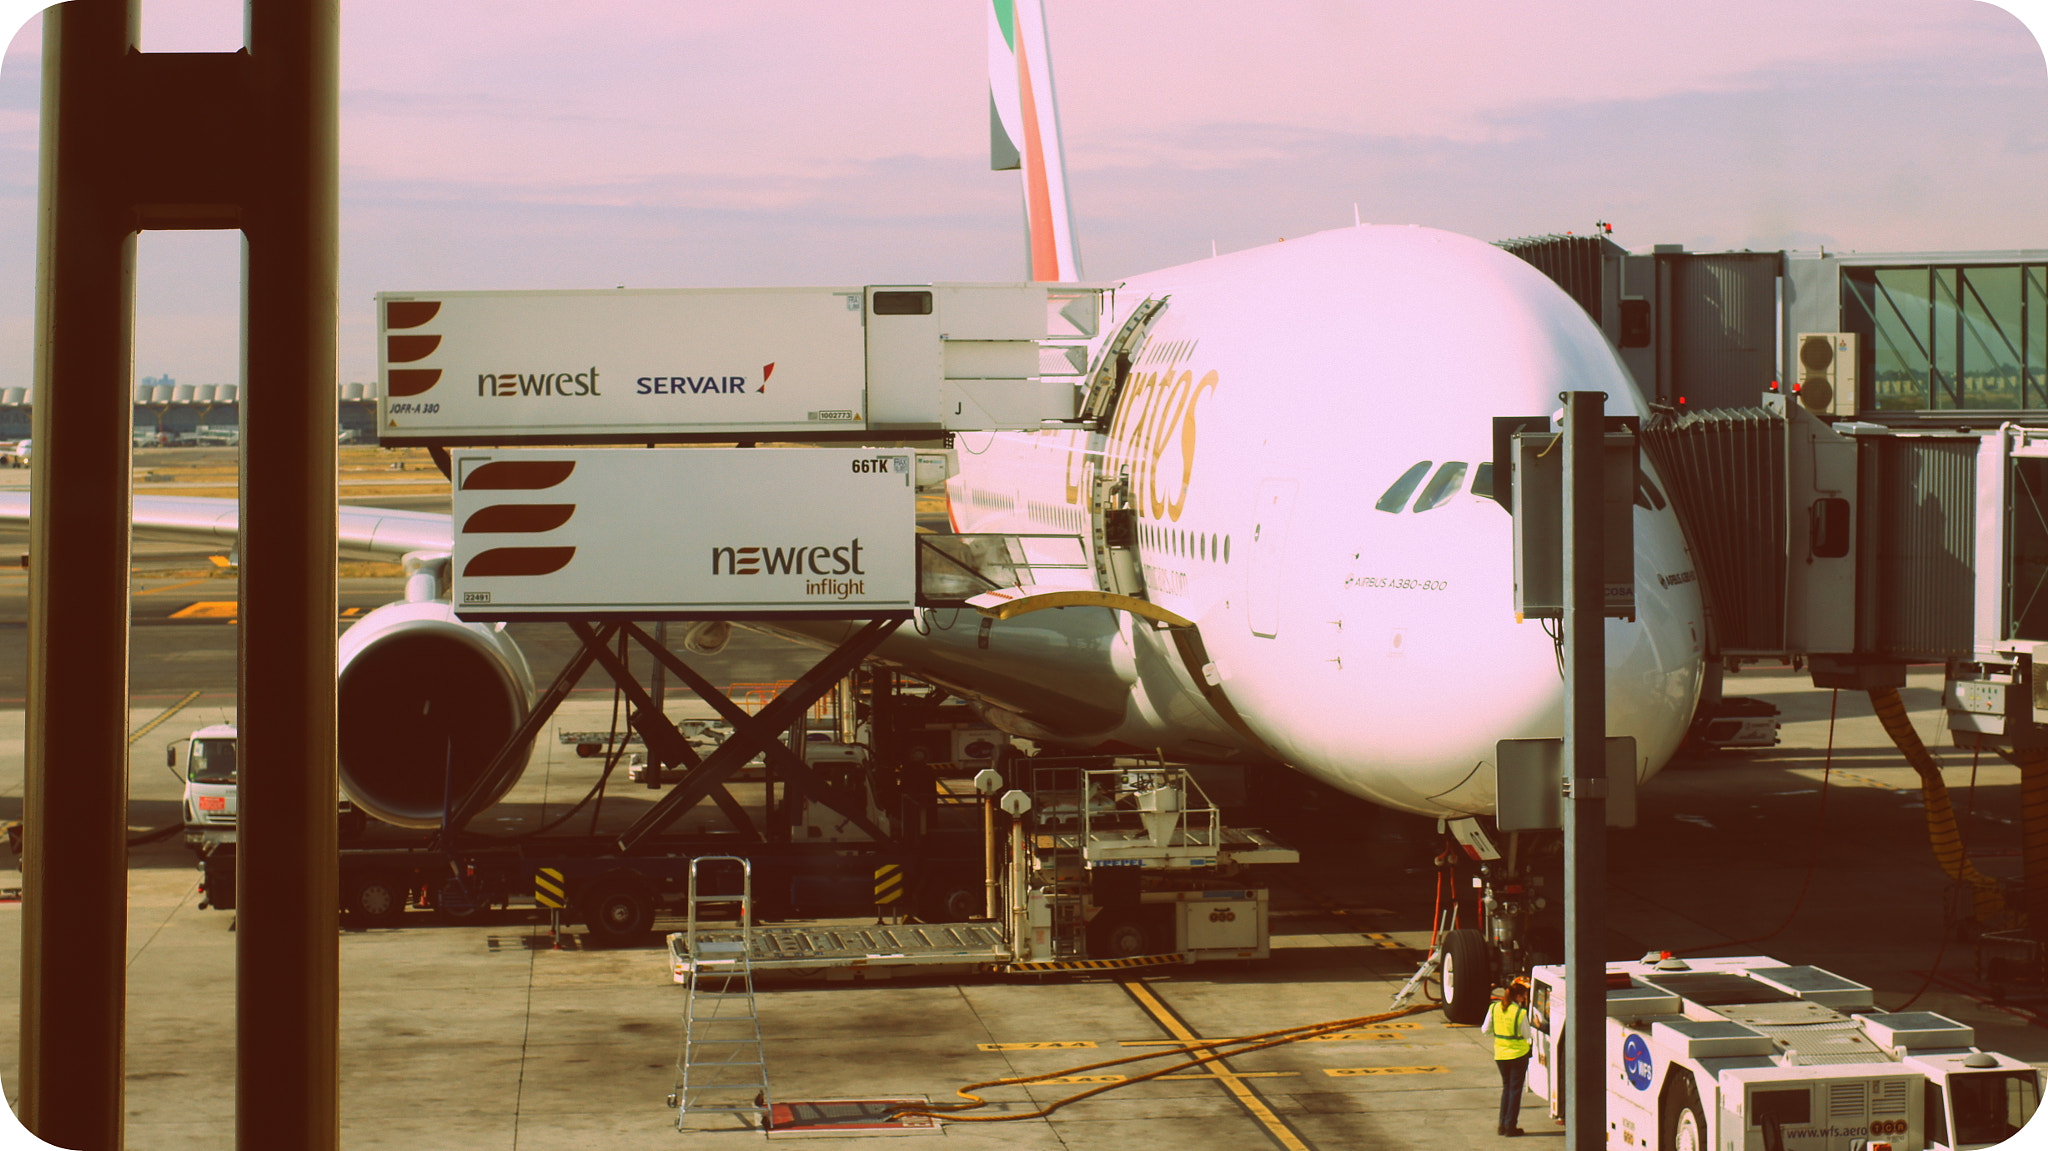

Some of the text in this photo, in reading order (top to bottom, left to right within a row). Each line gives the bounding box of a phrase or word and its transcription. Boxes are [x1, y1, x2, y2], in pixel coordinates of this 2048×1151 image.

[478, 366, 601, 397] newrest
[636, 376, 746, 394] SERVAIR
[422, 403, 440, 414] 380
[852, 459, 889, 473] 66TK
[712, 536, 865, 575] newrest
[805, 578, 865, 600] inflight
[1355, 577, 1448, 591] AIRBUS A380-800
[1637, 1060, 1652, 1080] WFS
[1786, 1125, 1868, 1139] www.wfs.aero
